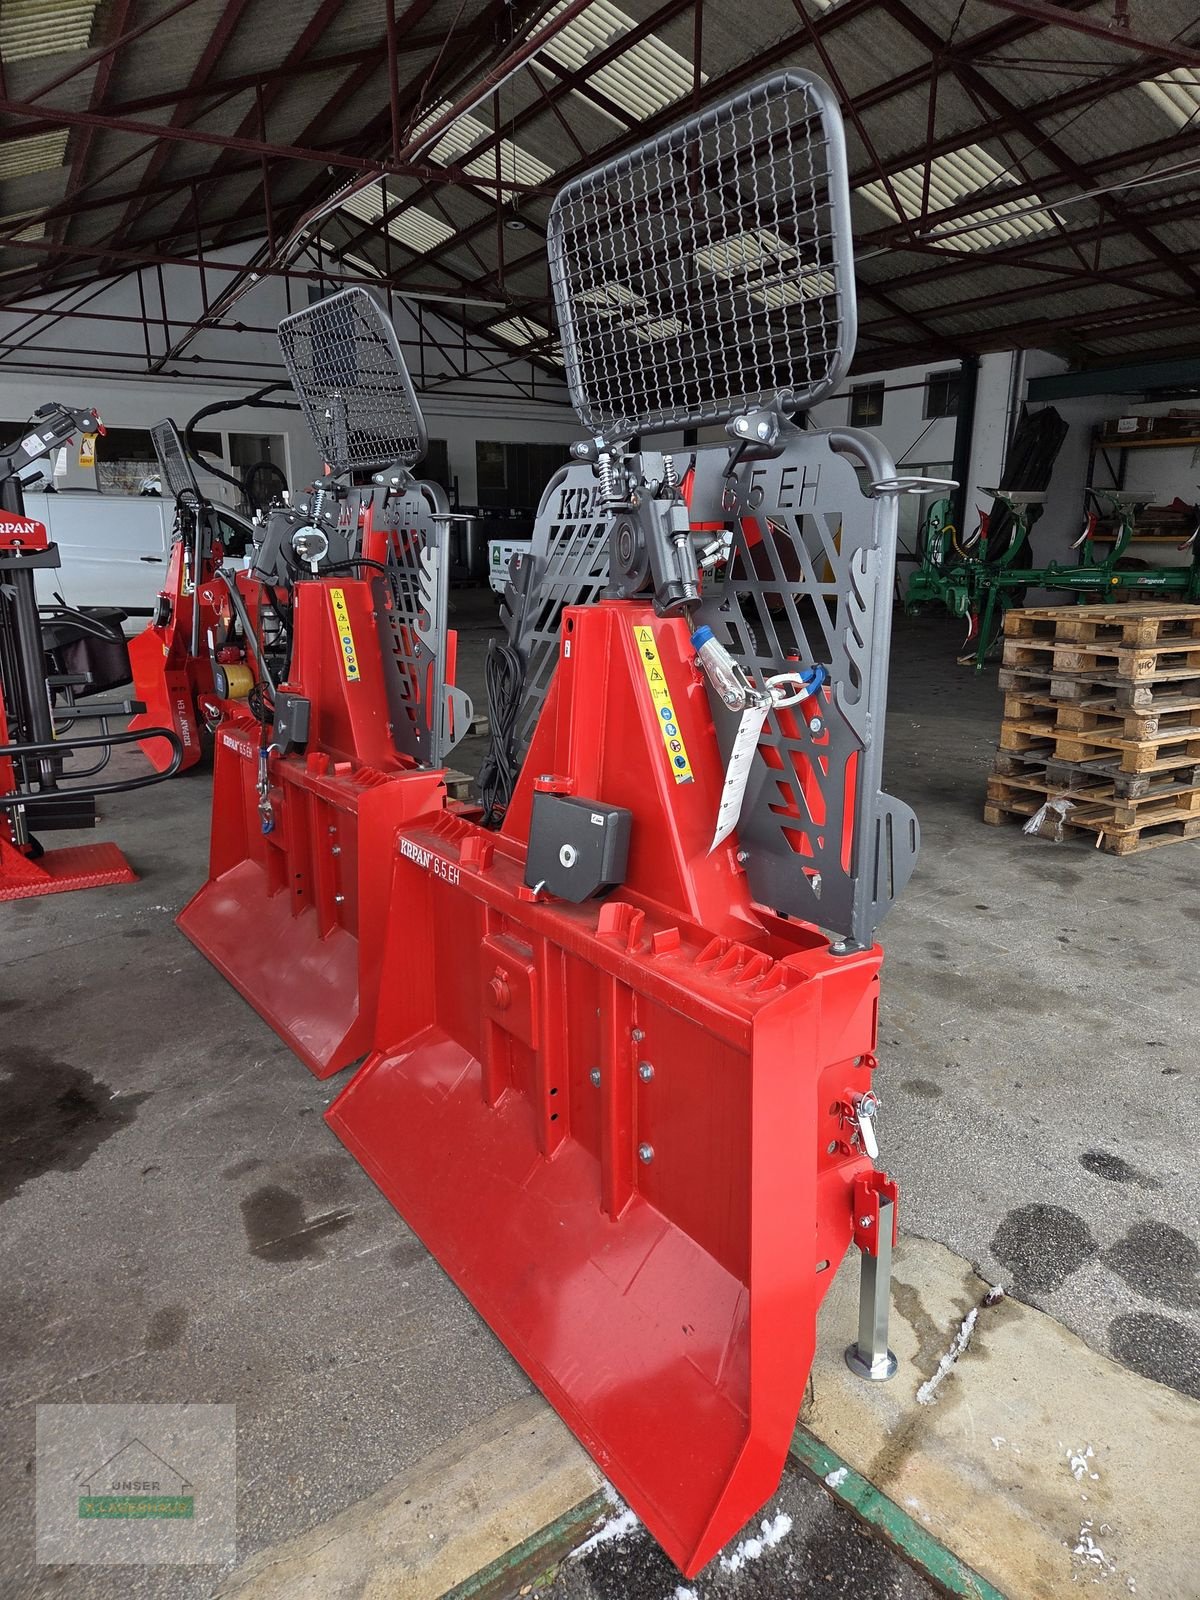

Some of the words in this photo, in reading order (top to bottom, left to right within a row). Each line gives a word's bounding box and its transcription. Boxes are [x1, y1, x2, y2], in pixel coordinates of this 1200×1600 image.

[776, 463, 822, 509] EH
[557, 486, 614, 520] KRP
[0, 522, 35, 533] RPAN
[177, 699, 186, 710] EH
[434, 857, 448, 878] 6,5
[448, 865, 460, 886] EH
